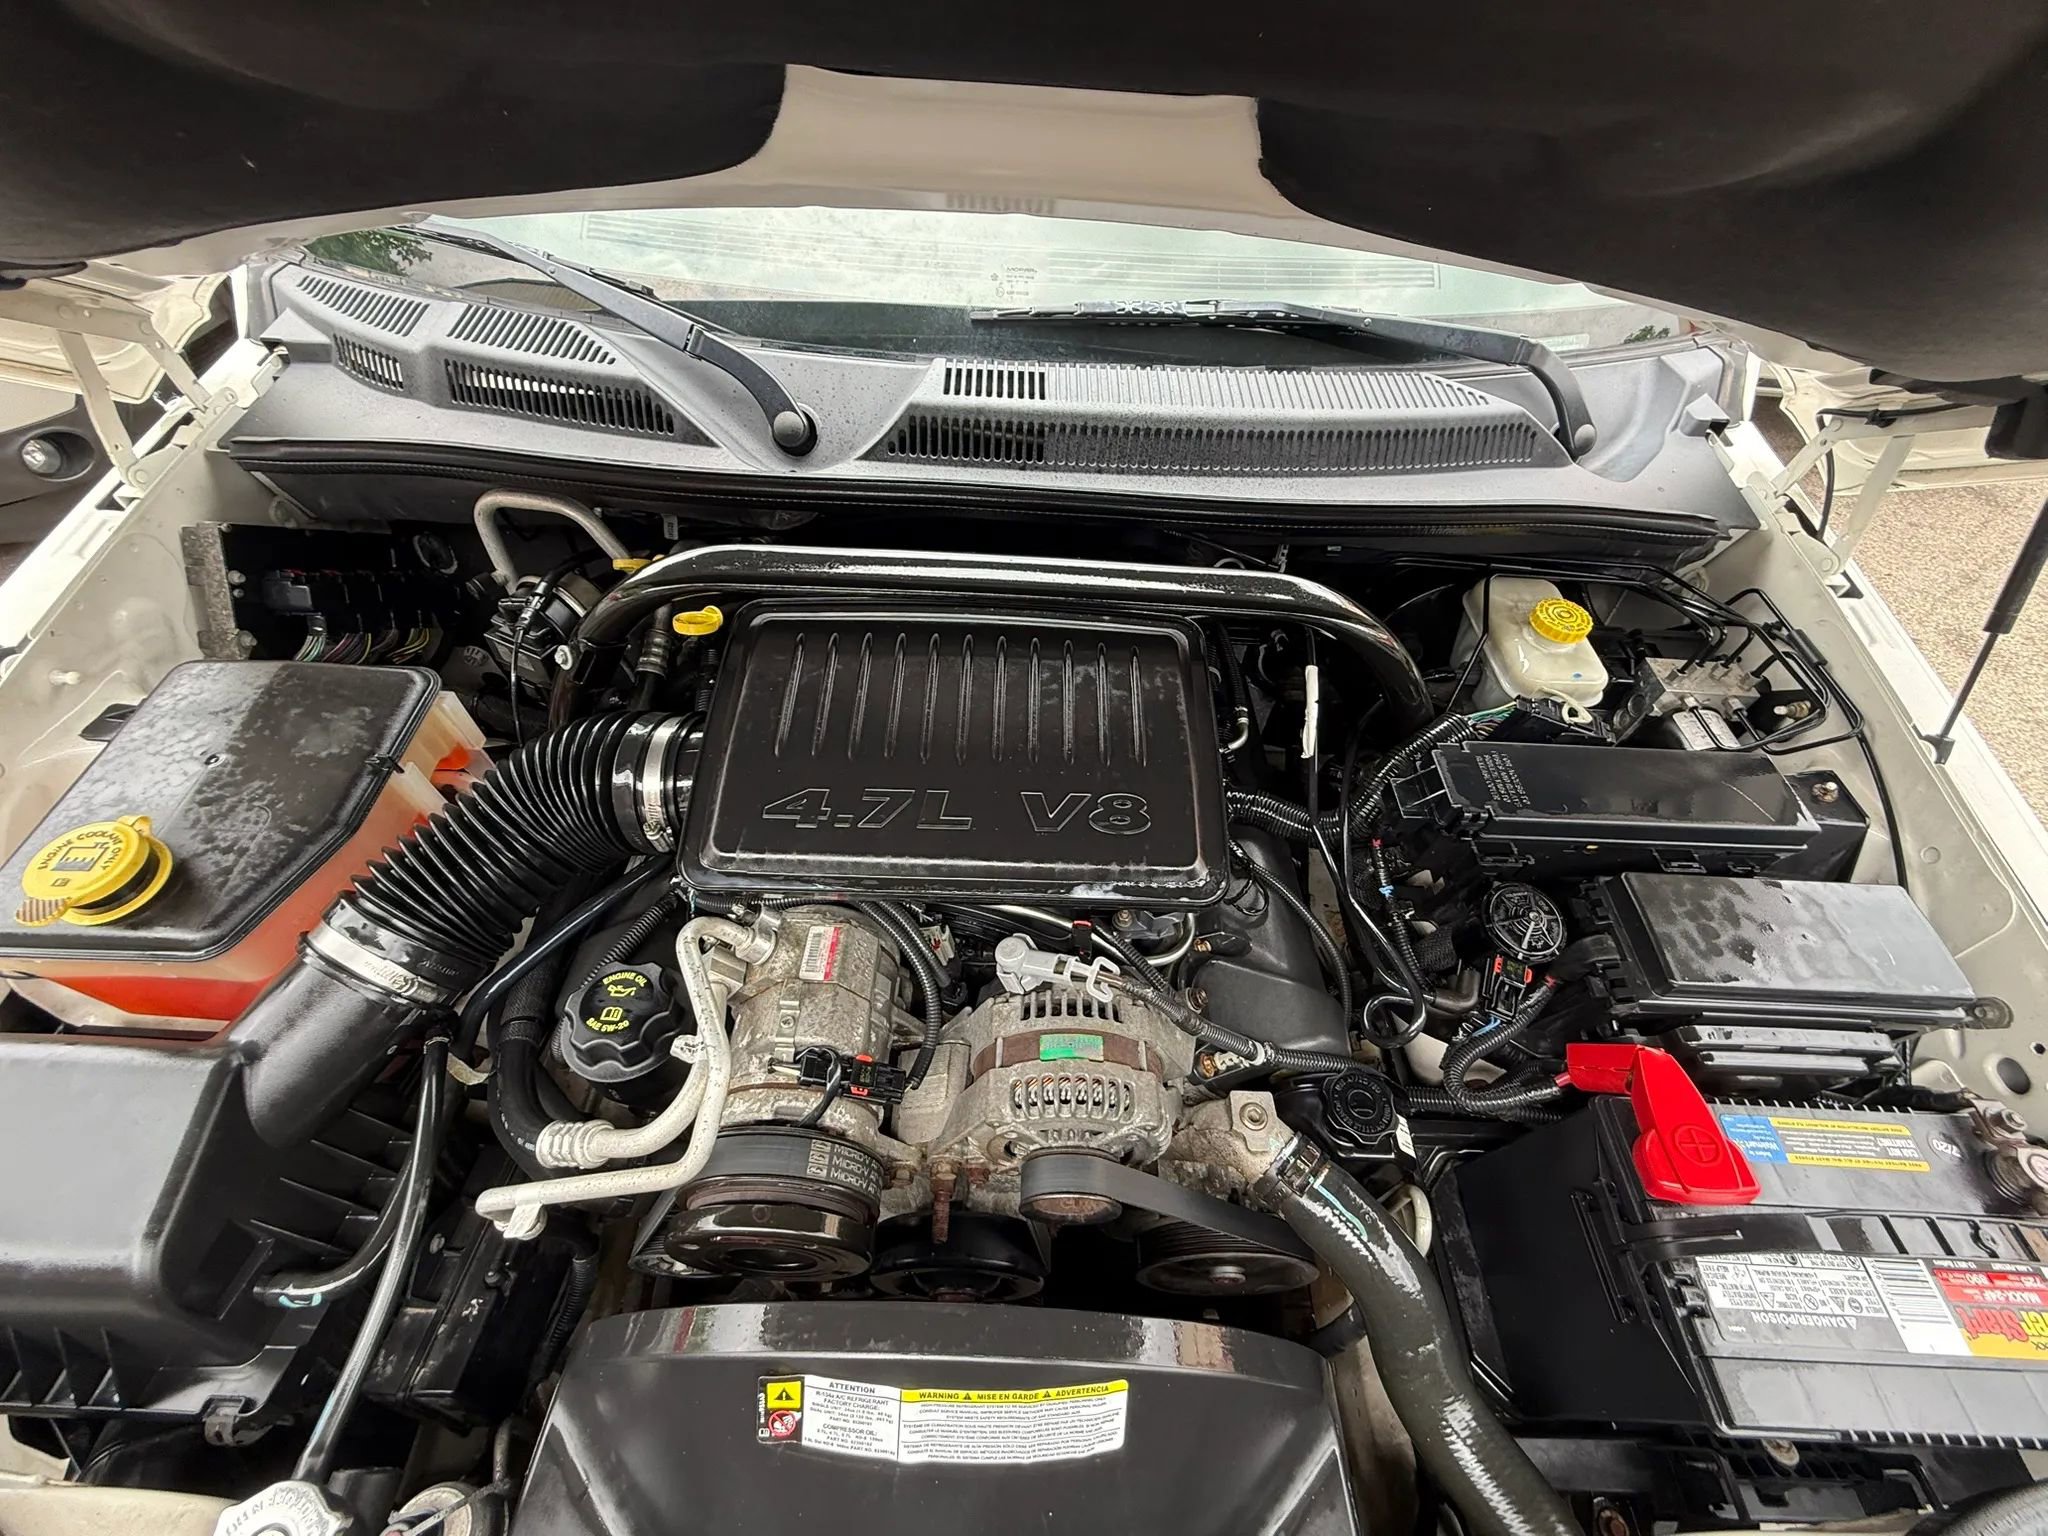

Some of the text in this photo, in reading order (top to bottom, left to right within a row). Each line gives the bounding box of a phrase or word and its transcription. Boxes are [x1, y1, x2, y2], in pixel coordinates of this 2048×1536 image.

[762, 788, 1152, 835] 4.7L V8
[37, 838, 74, 870] ENGINE
[100, 848, 121, 870] ONLY
[602, 972, 648, 988] ENGINE OIL
[586, 1018, 630, 1032] SAE 5W-20
[834, 1144, 870, 1164] MICRO-V
[832, 1155, 870, 1177] MICRO-V
[831, 1168, 868, 1190] MICRO-V
[1751, 1312, 1848, 1328] DANGER/POISON
[829, 1382, 875, 1394] ATTENTION
[1056, 1386, 1109, 1397] ADVERTENCIA
[847, 1396, 889, 1406] REFRIGERANT
[823, 1423, 865, 1434] COMPRESSOR
